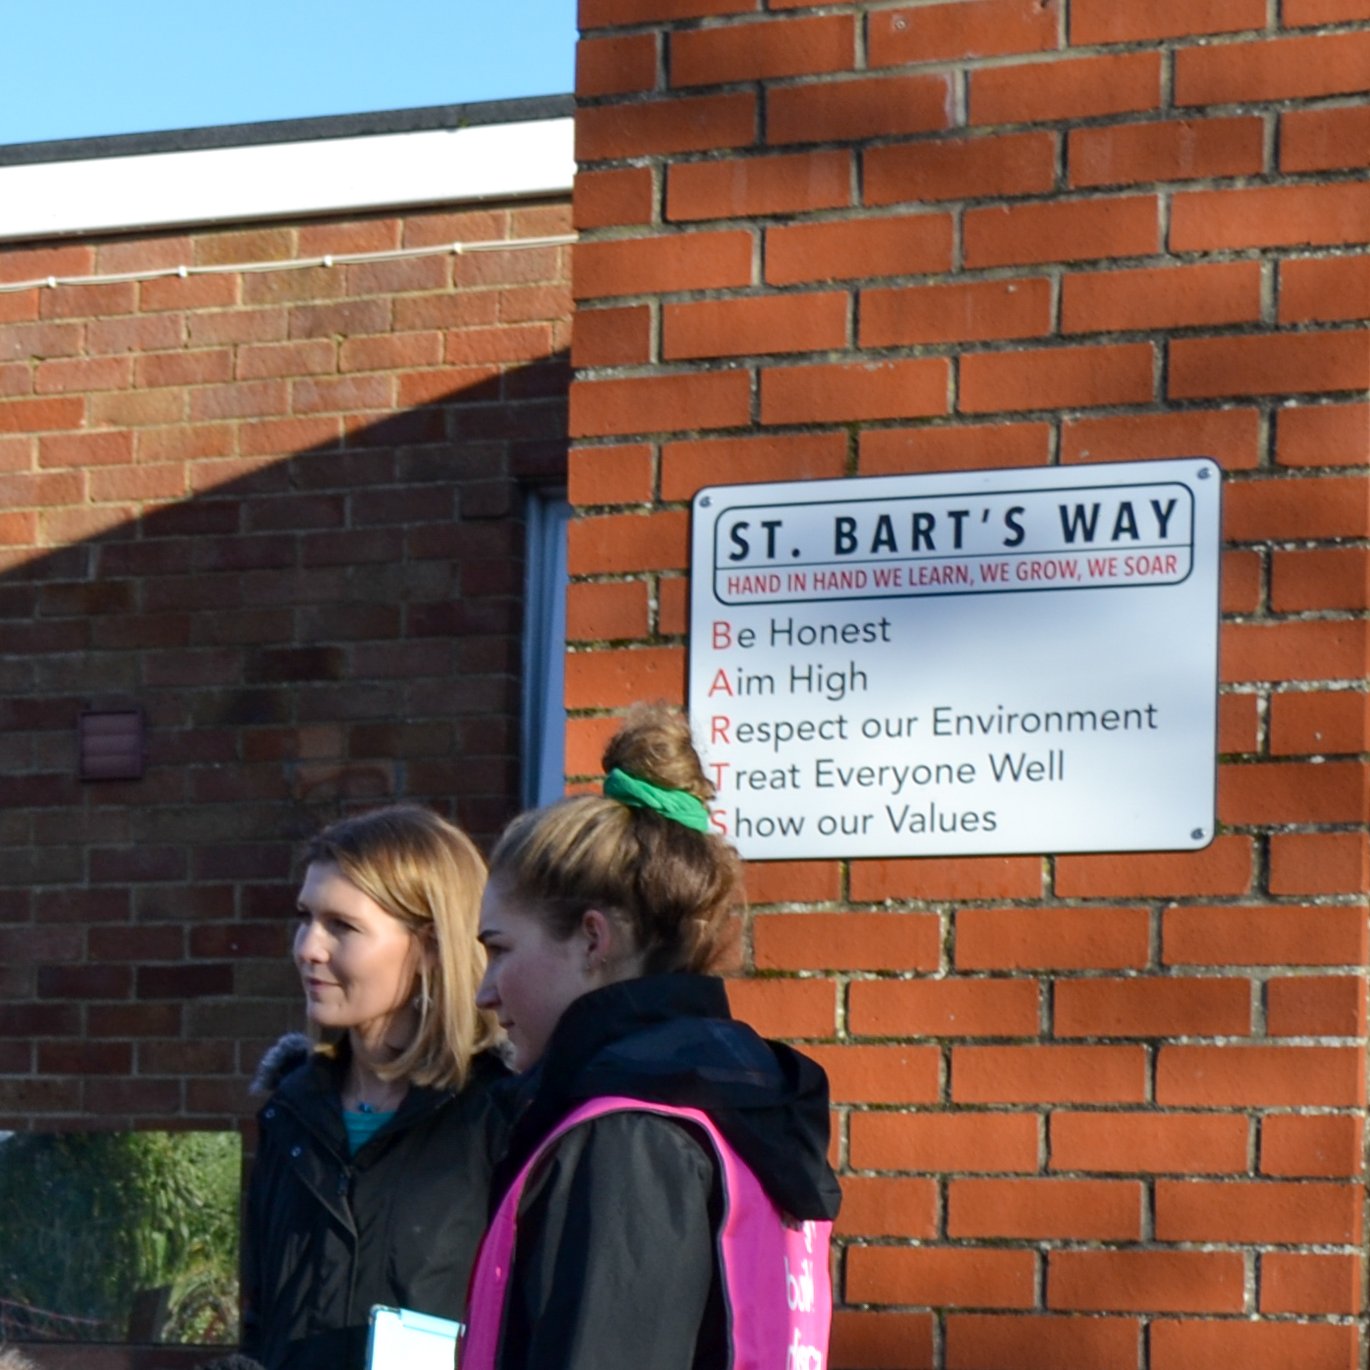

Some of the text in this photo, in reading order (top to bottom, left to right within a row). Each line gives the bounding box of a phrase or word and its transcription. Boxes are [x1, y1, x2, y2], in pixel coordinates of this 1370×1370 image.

[728, 498, 1178, 561] ST. BART'S WAY
[727, 554, 1177, 595] HAND IN HAND WE LEARN, WE GROW, WE SOAR
[712, 617, 891, 649] Be Honest
[708, 660, 867, 701] Aim High
[711, 704, 1158, 752] Respect our Environment
[710, 749, 1064, 795] Treat Everyone Well
[710, 802, 997, 837] Show our Values
